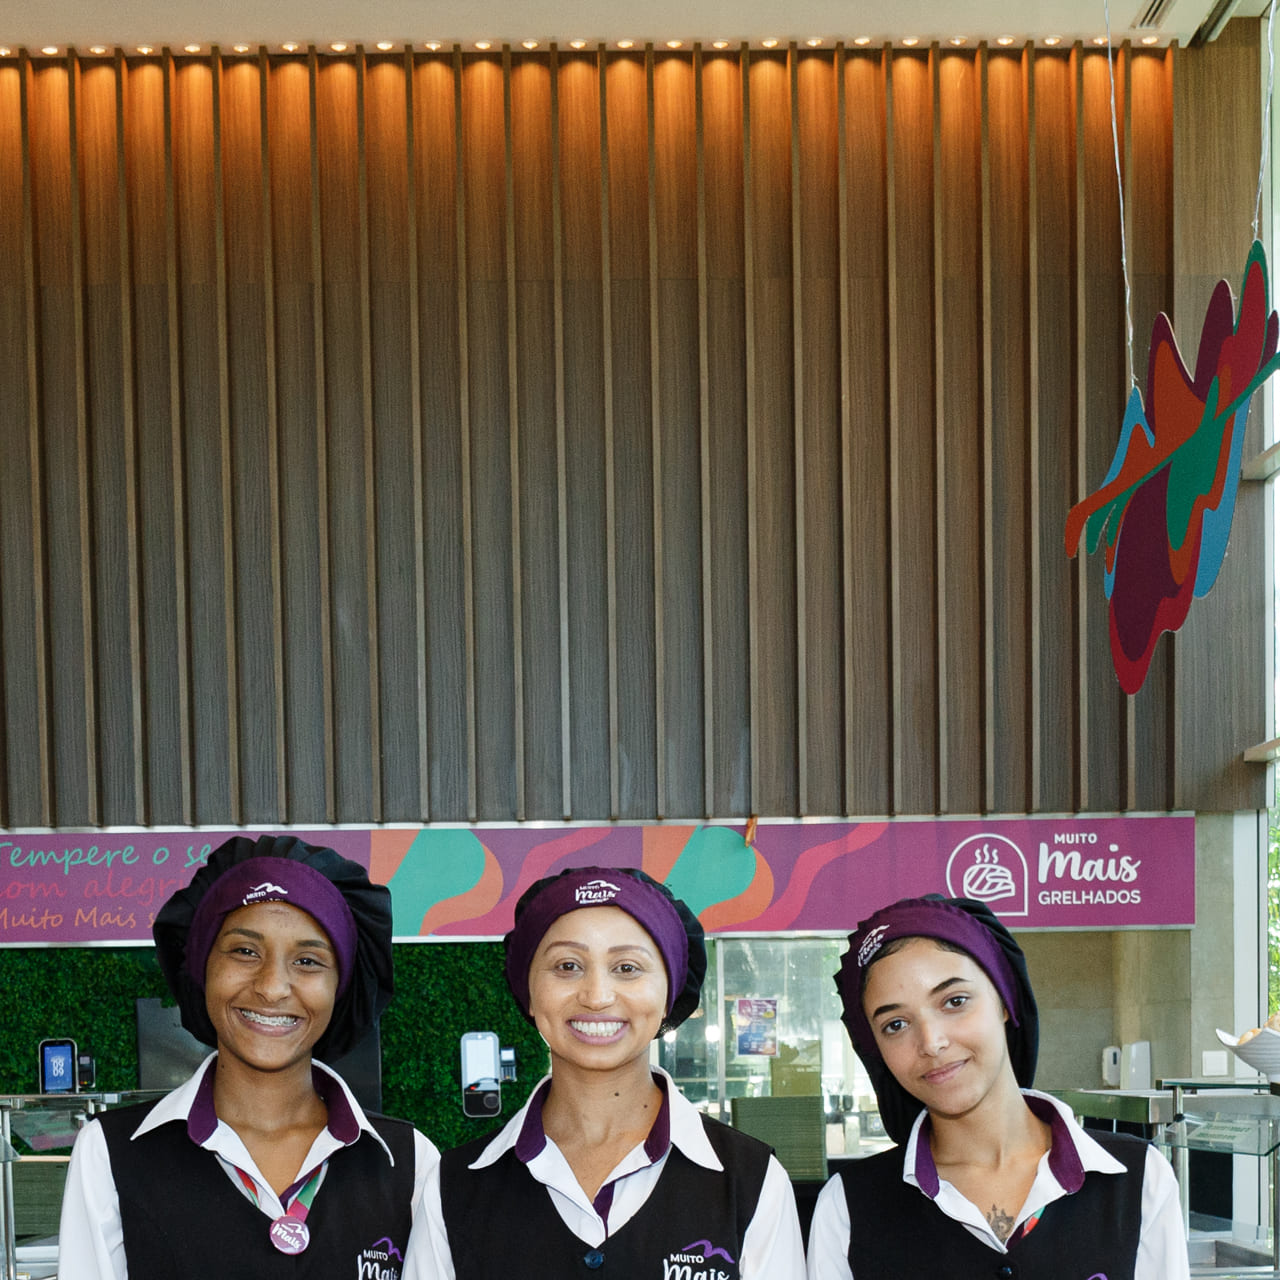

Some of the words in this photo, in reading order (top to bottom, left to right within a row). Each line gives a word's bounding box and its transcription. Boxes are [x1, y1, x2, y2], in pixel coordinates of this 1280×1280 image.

[1054, 833, 1098, 844] MUITO
[152, 847, 170, 864] o
[84, 868, 185, 906] alegri
[1038, 890, 1141, 905] GRELHADOS
[74, 906, 137, 929] Mais
[363, 1249, 389, 1261] MUITO
[669, 1253, 705, 1264] MUITO
